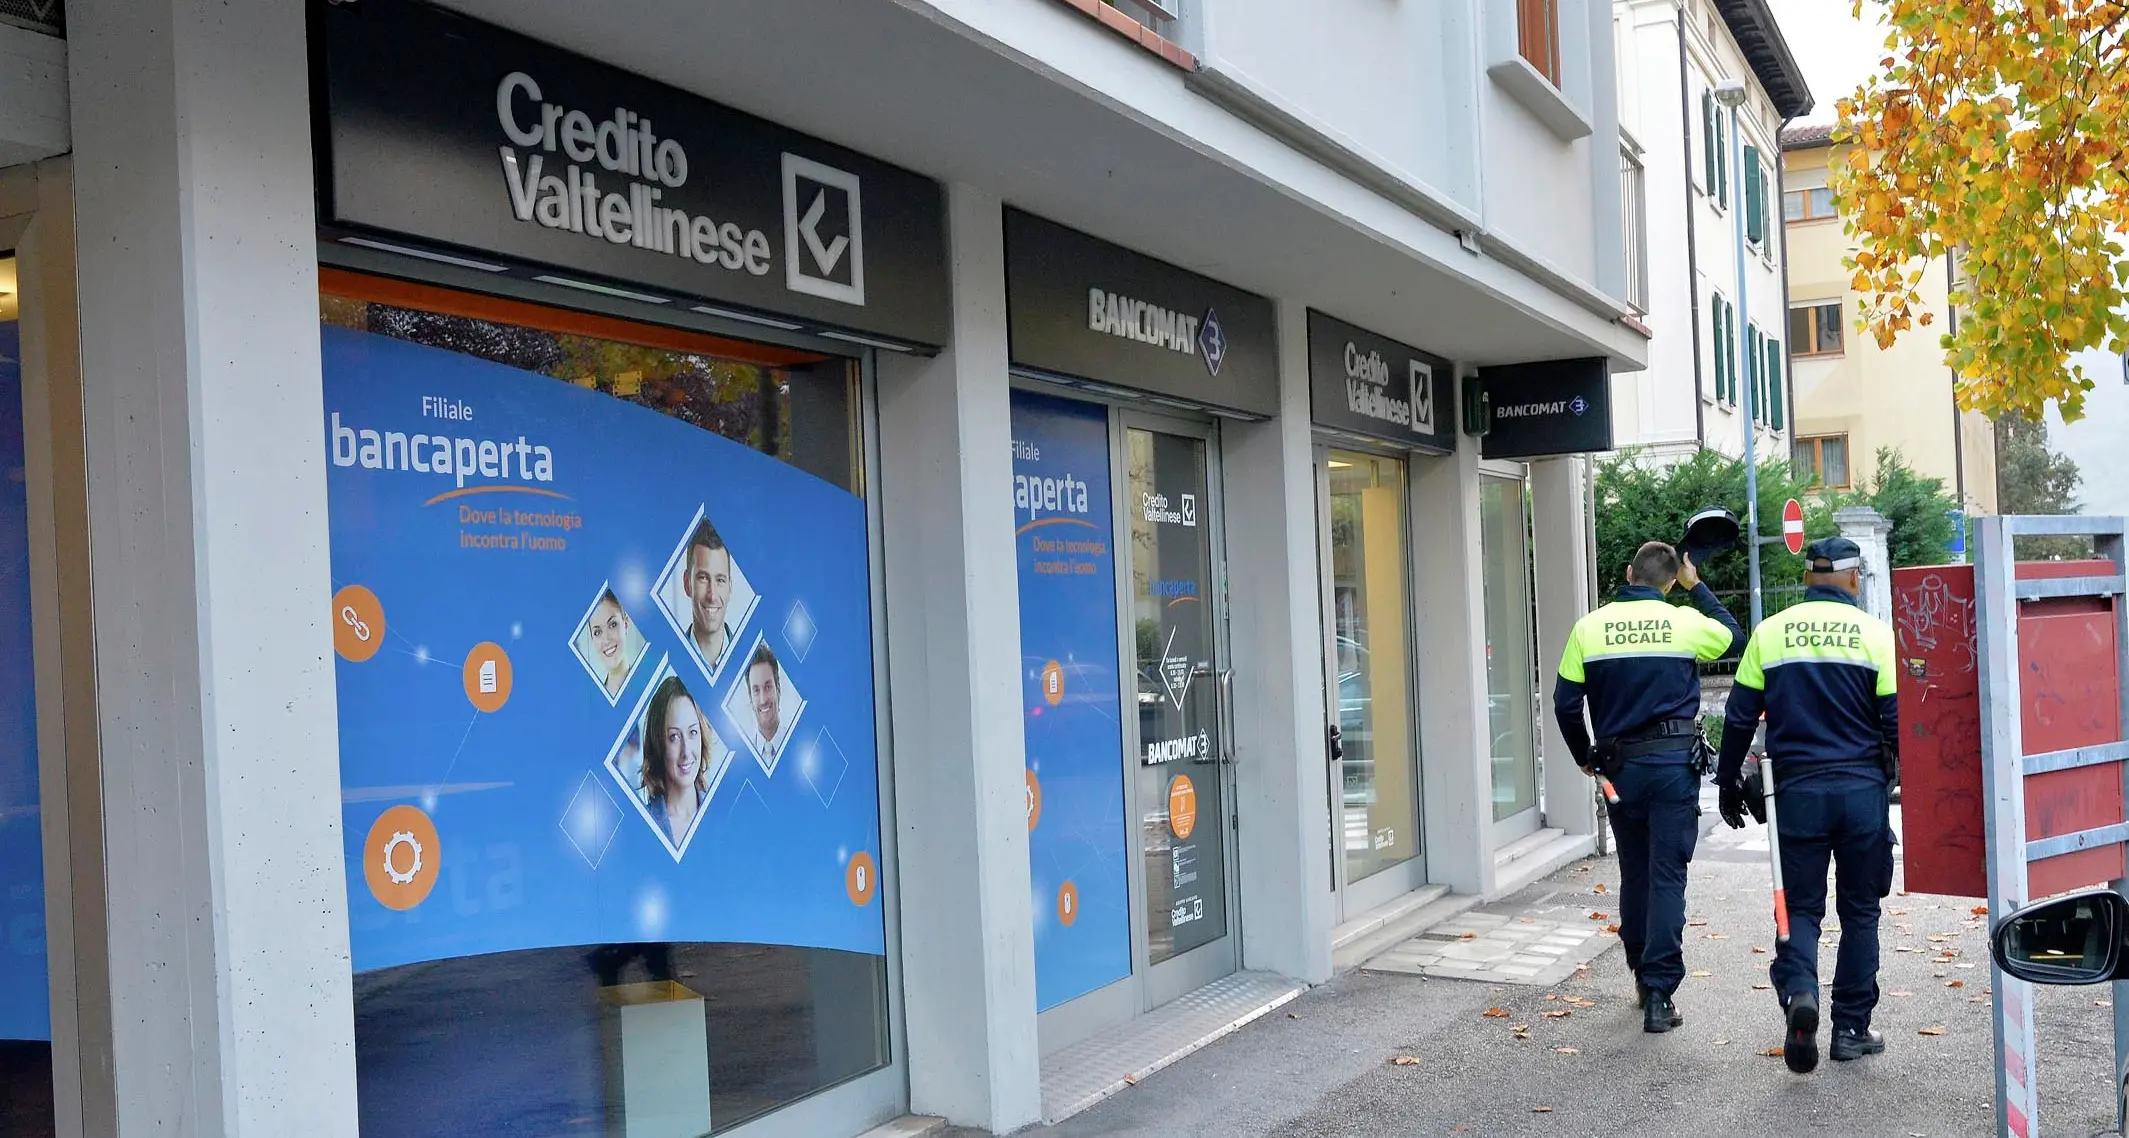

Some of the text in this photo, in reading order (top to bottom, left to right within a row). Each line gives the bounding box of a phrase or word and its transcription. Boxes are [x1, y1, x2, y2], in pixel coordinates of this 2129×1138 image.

[496, 71, 688, 188] Credito
[500, 146, 771, 276] Valtellinese
[1089, 287, 1198, 355] BANCOMAT
[1344, 341, 1389, 387] Credito
[422, 396, 473, 421] Filiale
[1345, 378, 1410, 426] Valtellinese
[1496, 400, 1567, 419] BANCOMAT
[331, 412, 553, 488] bancaperta
[1013, 473, 1088, 520] aperta
[1142, 492, 1168, 509] Credito
[459, 505, 583, 529] Dove la tecnologia
[1142, 506, 1181, 524] Valtellinese
[459, 529, 566, 551] incontra l'uomo
[1605, 619, 1672, 633] POLIZIA
[1784, 621, 1862, 635] POLIZIA
[1605, 632, 1672, 646] LOCALE
[1785, 635, 1861, 650] LOCALE
[1148, 736, 1198, 765] BANCOMAT
